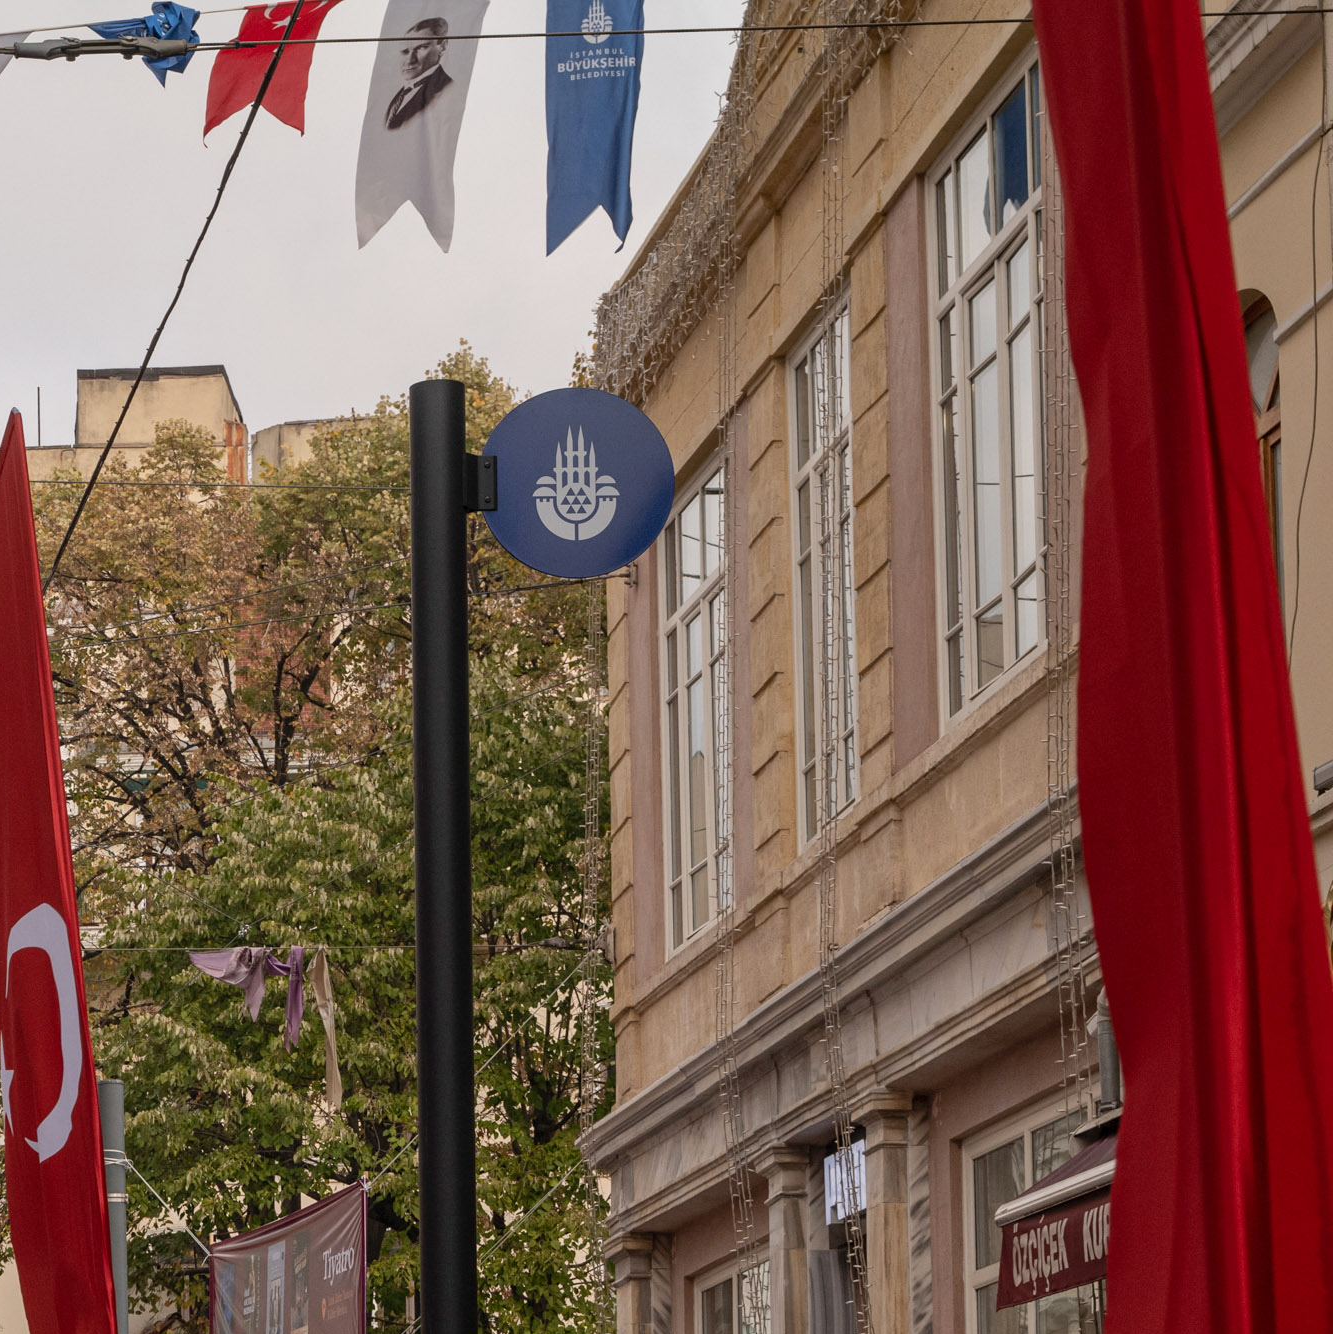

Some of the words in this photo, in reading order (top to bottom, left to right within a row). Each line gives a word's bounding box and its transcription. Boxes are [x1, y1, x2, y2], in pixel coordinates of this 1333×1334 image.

[570, 48, 625, 59] İSTANBUL
[557, 56, 636, 73] BÜYÜKŞEHİR
[570, 69, 625, 81] BELEDİYESİ
[322, 1247, 355, 1287] Tiyatro
